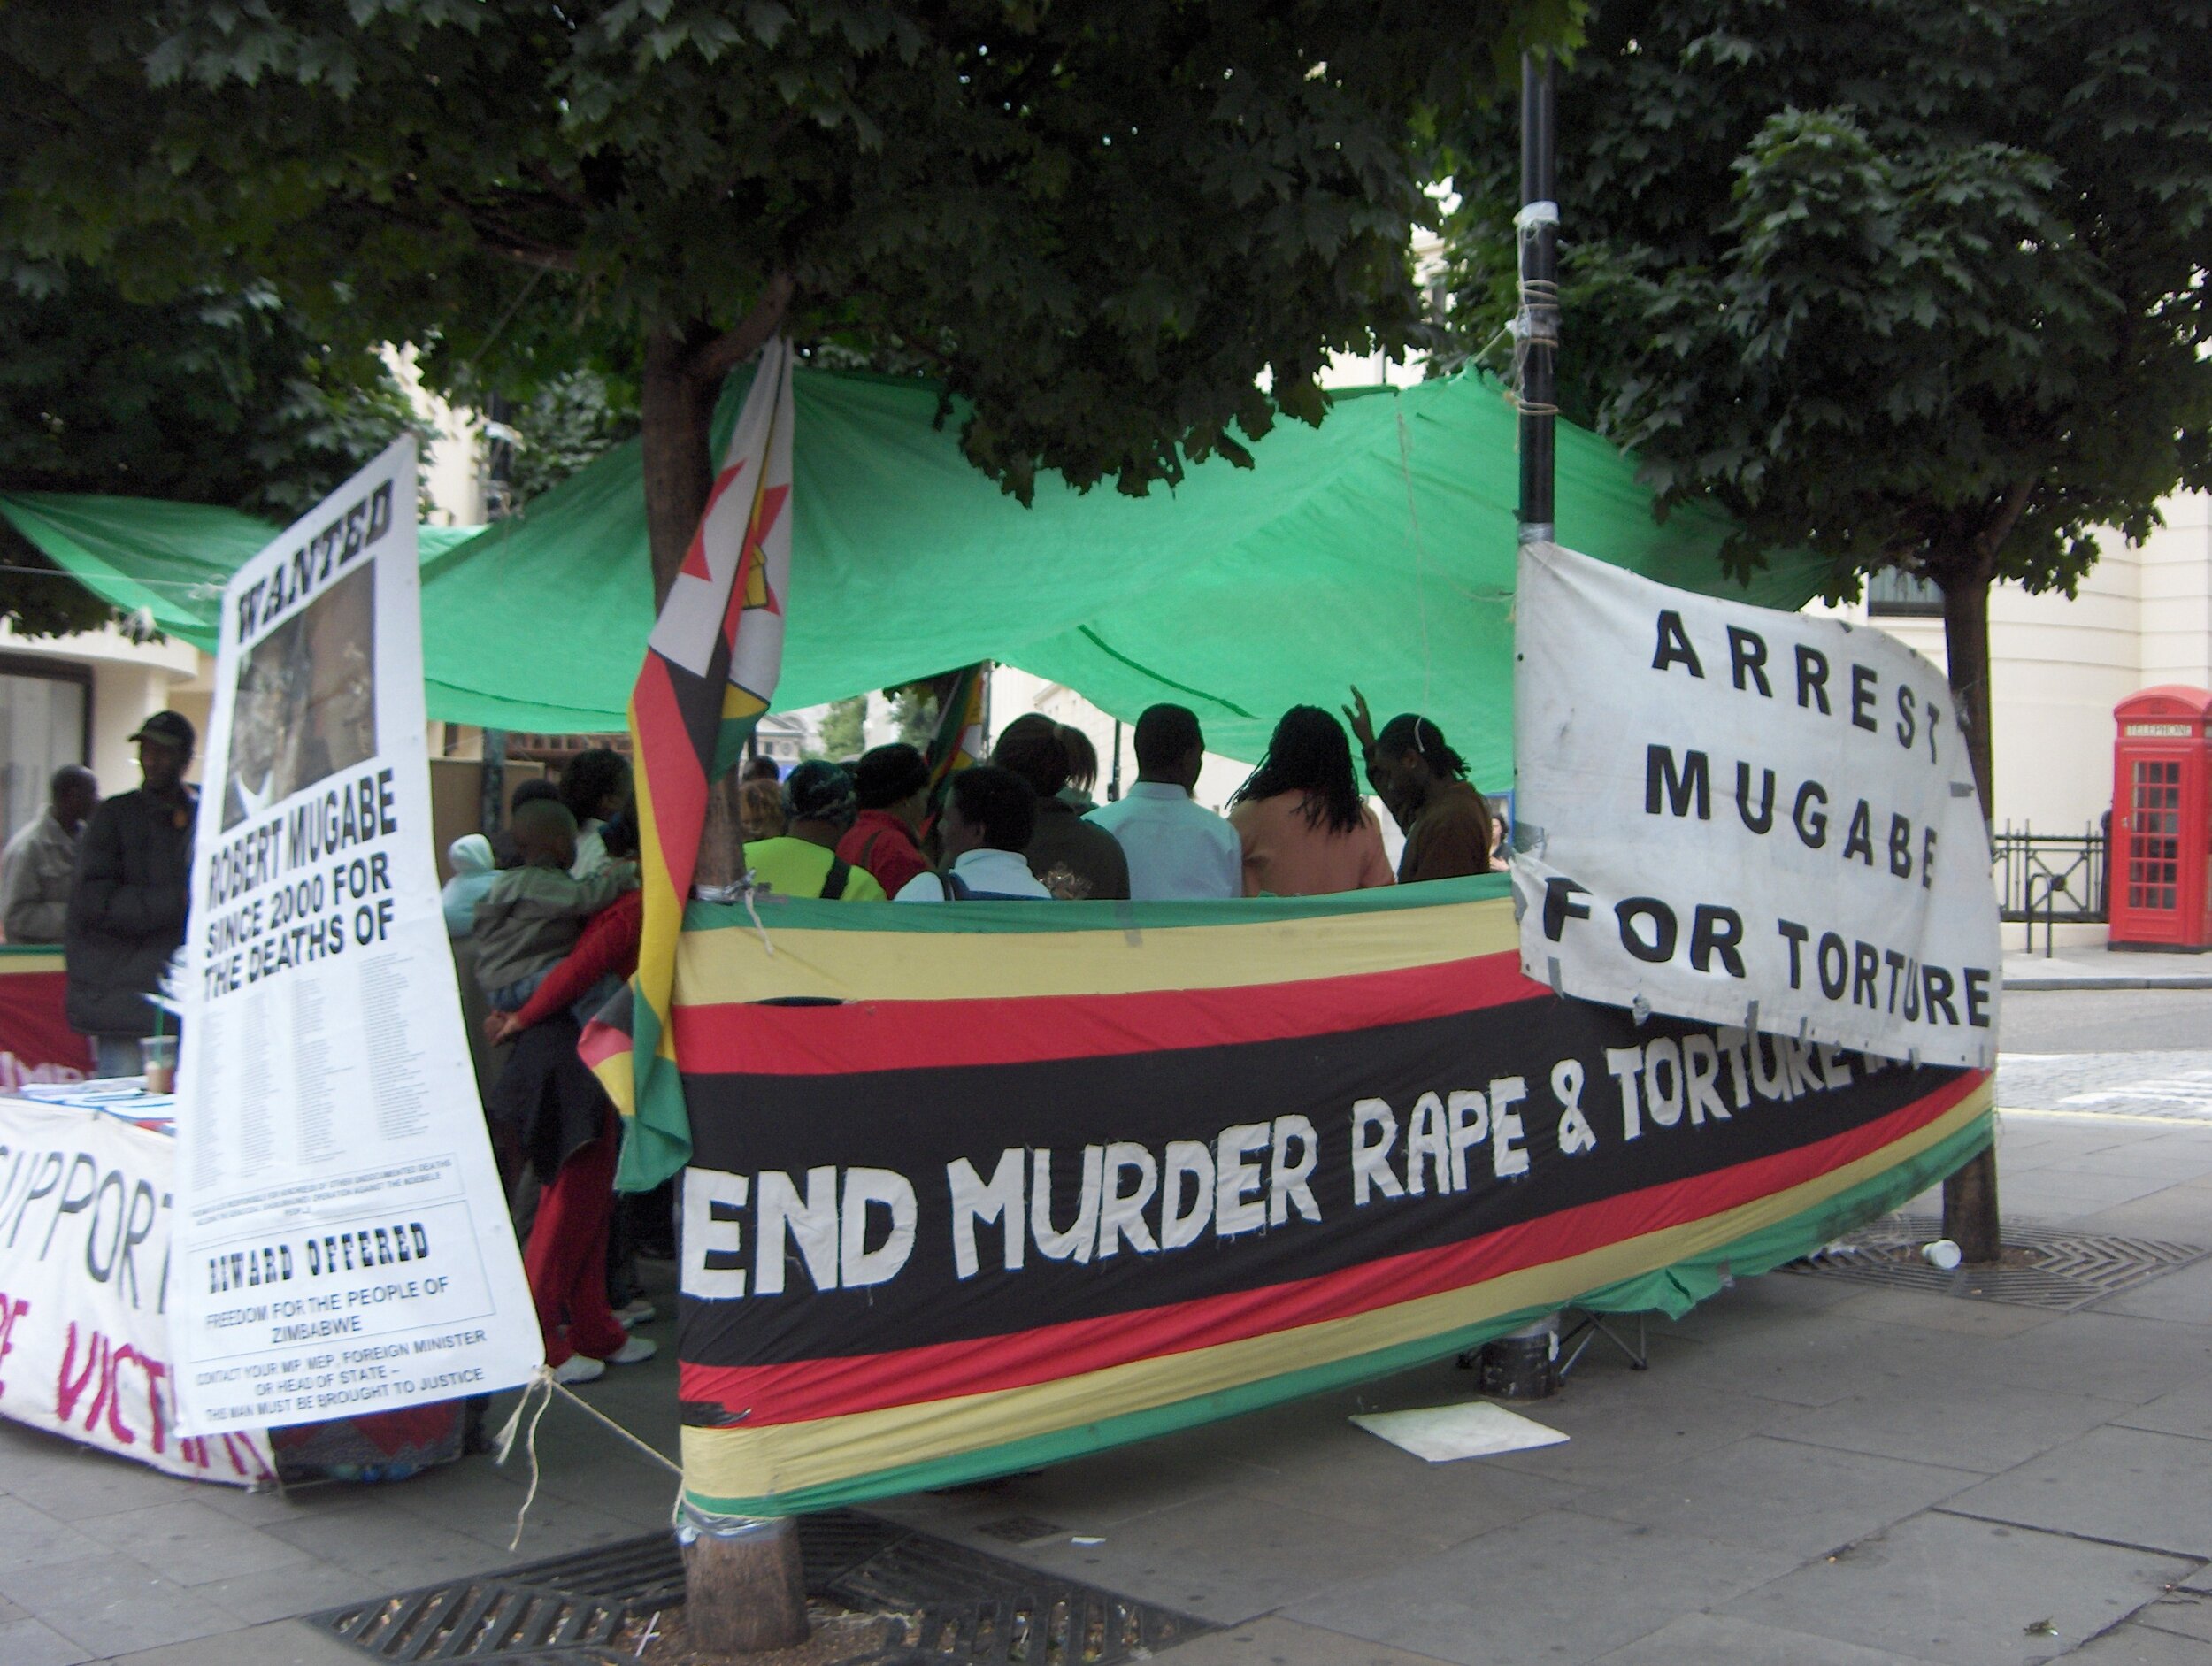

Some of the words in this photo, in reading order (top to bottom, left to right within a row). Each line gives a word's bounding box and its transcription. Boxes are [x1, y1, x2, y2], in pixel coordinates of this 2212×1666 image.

[238, 478, 394, 644] WANTED
[1651, 608, 1940, 765] ARREST
[2128, 724, 2191, 736] TELEPHONE
[207, 816, 284, 913] ROBERT
[286, 766, 398, 872] MUGABE
[1644, 743, 1938, 890] MUGABE
[204, 898, 263, 960] SINCE
[269, 872, 325, 930] 2000
[333, 850, 392, 906] FOR
[204, 953, 243, 1002] THE
[248, 913, 346, 984] DEATHS
[355, 896, 395, 946] OF
[1542, 877, 1747, 979] FOR
[1778, 917, 1992, 1028] TORTURE
[679, 1164, 918, 1301] END
[946, 1113, 1323, 1280] MURDER
[1350, 1076, 1530, 1206] RAPE
[1550, 1059, 1596, 1154] &
[1604, 1025, 1854, 1142] TORTURE
[306, 1221, 431, 1277] OFFERED
[204, 1304, 269, 1330] FREEDOM
[272, 1298, 305, 1319] FOR
[307, 1293, 342, 1313] THE
[347, 1280, 420, 1308] PEOPLE
[423, 1276, 449, 1295] OF
[244, 1363, 278, 1379] YOUR
[342, 1341, 411, 1364] FOREIGN
[413, 1329, 488, 1354] MINISTER
[272, 1314, 364, 1345] ZIMBABWE
[254, 1381, 275, 1397] OR
[277, 1376, 313, 1393] HEAD
[316, 1372, 335, 1389] OF
[340, 1364, 388, 1385] STATE
[257, 1399, 292, 1416] MUST
[296, 1395, 314, 1410] BE
[316, 1384, 390, 1407] BROUGHT
[392, 1379, 416, 1395] TO
[419, 1367, 486, 1391] JUSTICE
